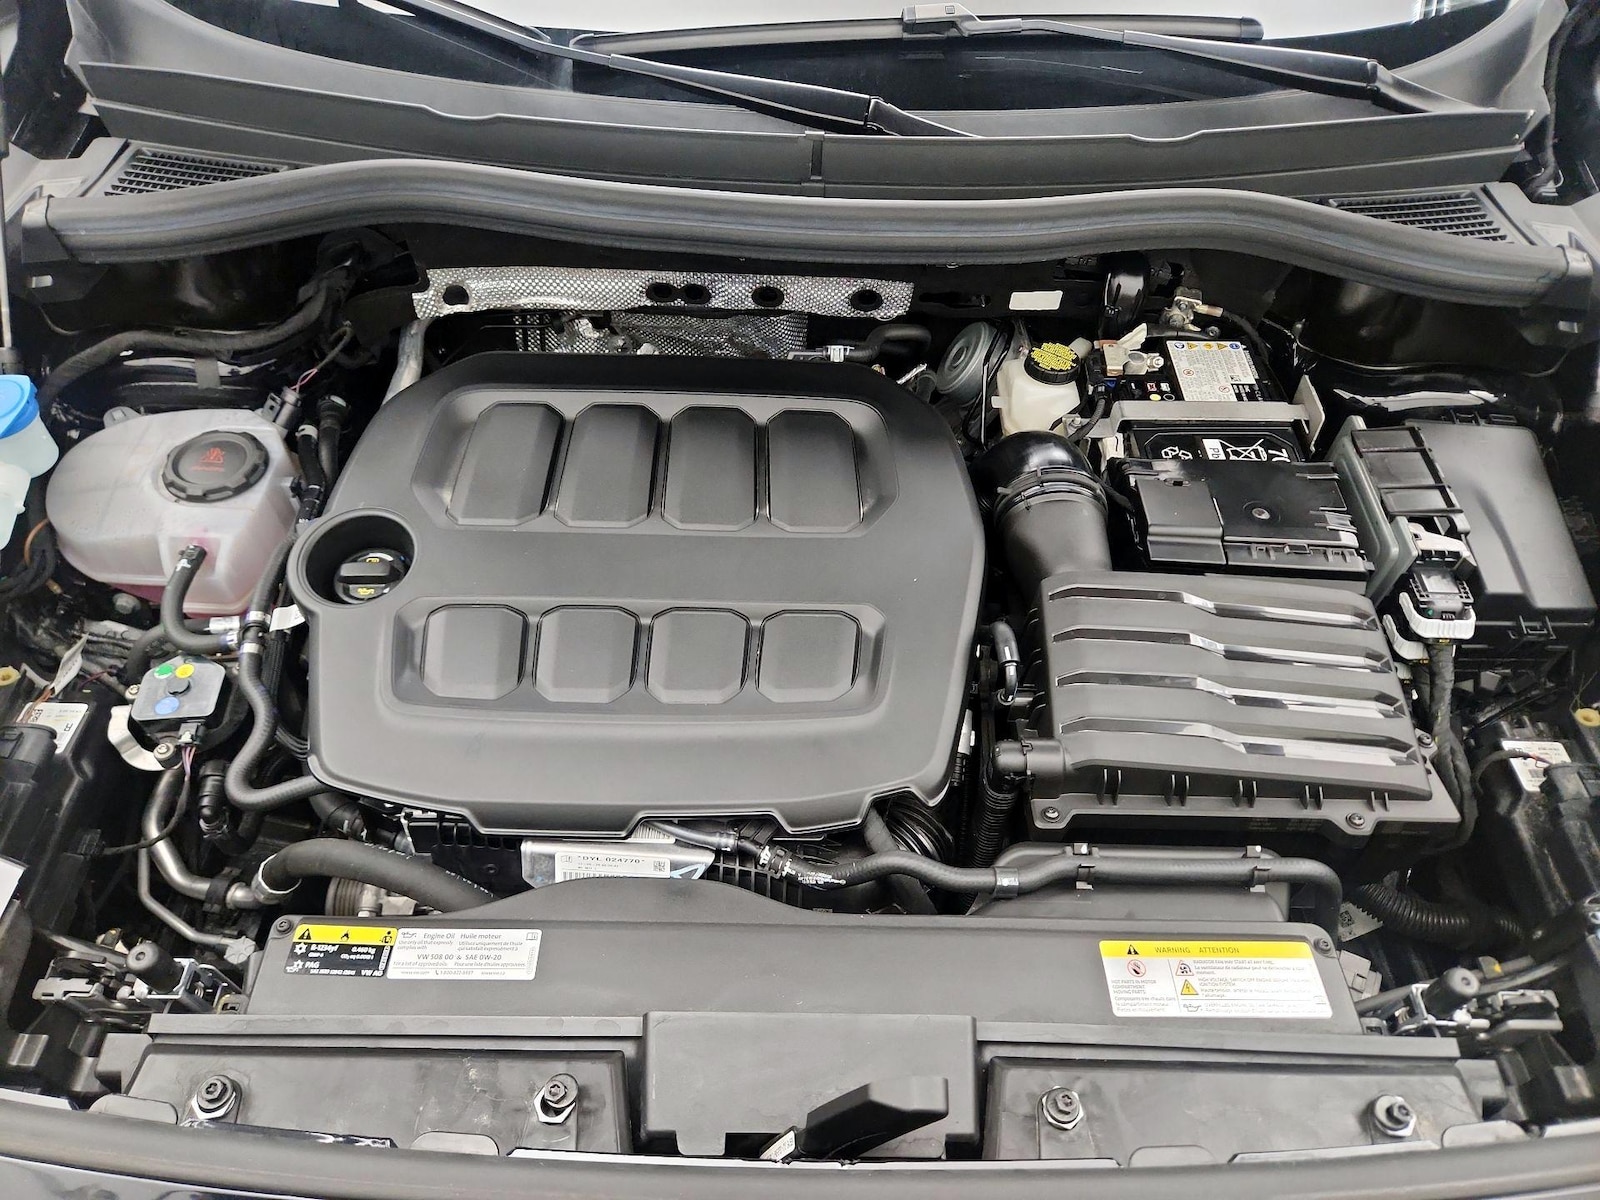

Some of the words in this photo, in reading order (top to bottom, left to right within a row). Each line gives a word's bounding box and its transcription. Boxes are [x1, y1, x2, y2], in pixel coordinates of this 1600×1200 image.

[1209, 447, 1221, 459] Pb
[424, 932, 445, 941] Engine
[460, 932, 477, 940] Huile
[311, 944, 339, 953] R-1234yf
